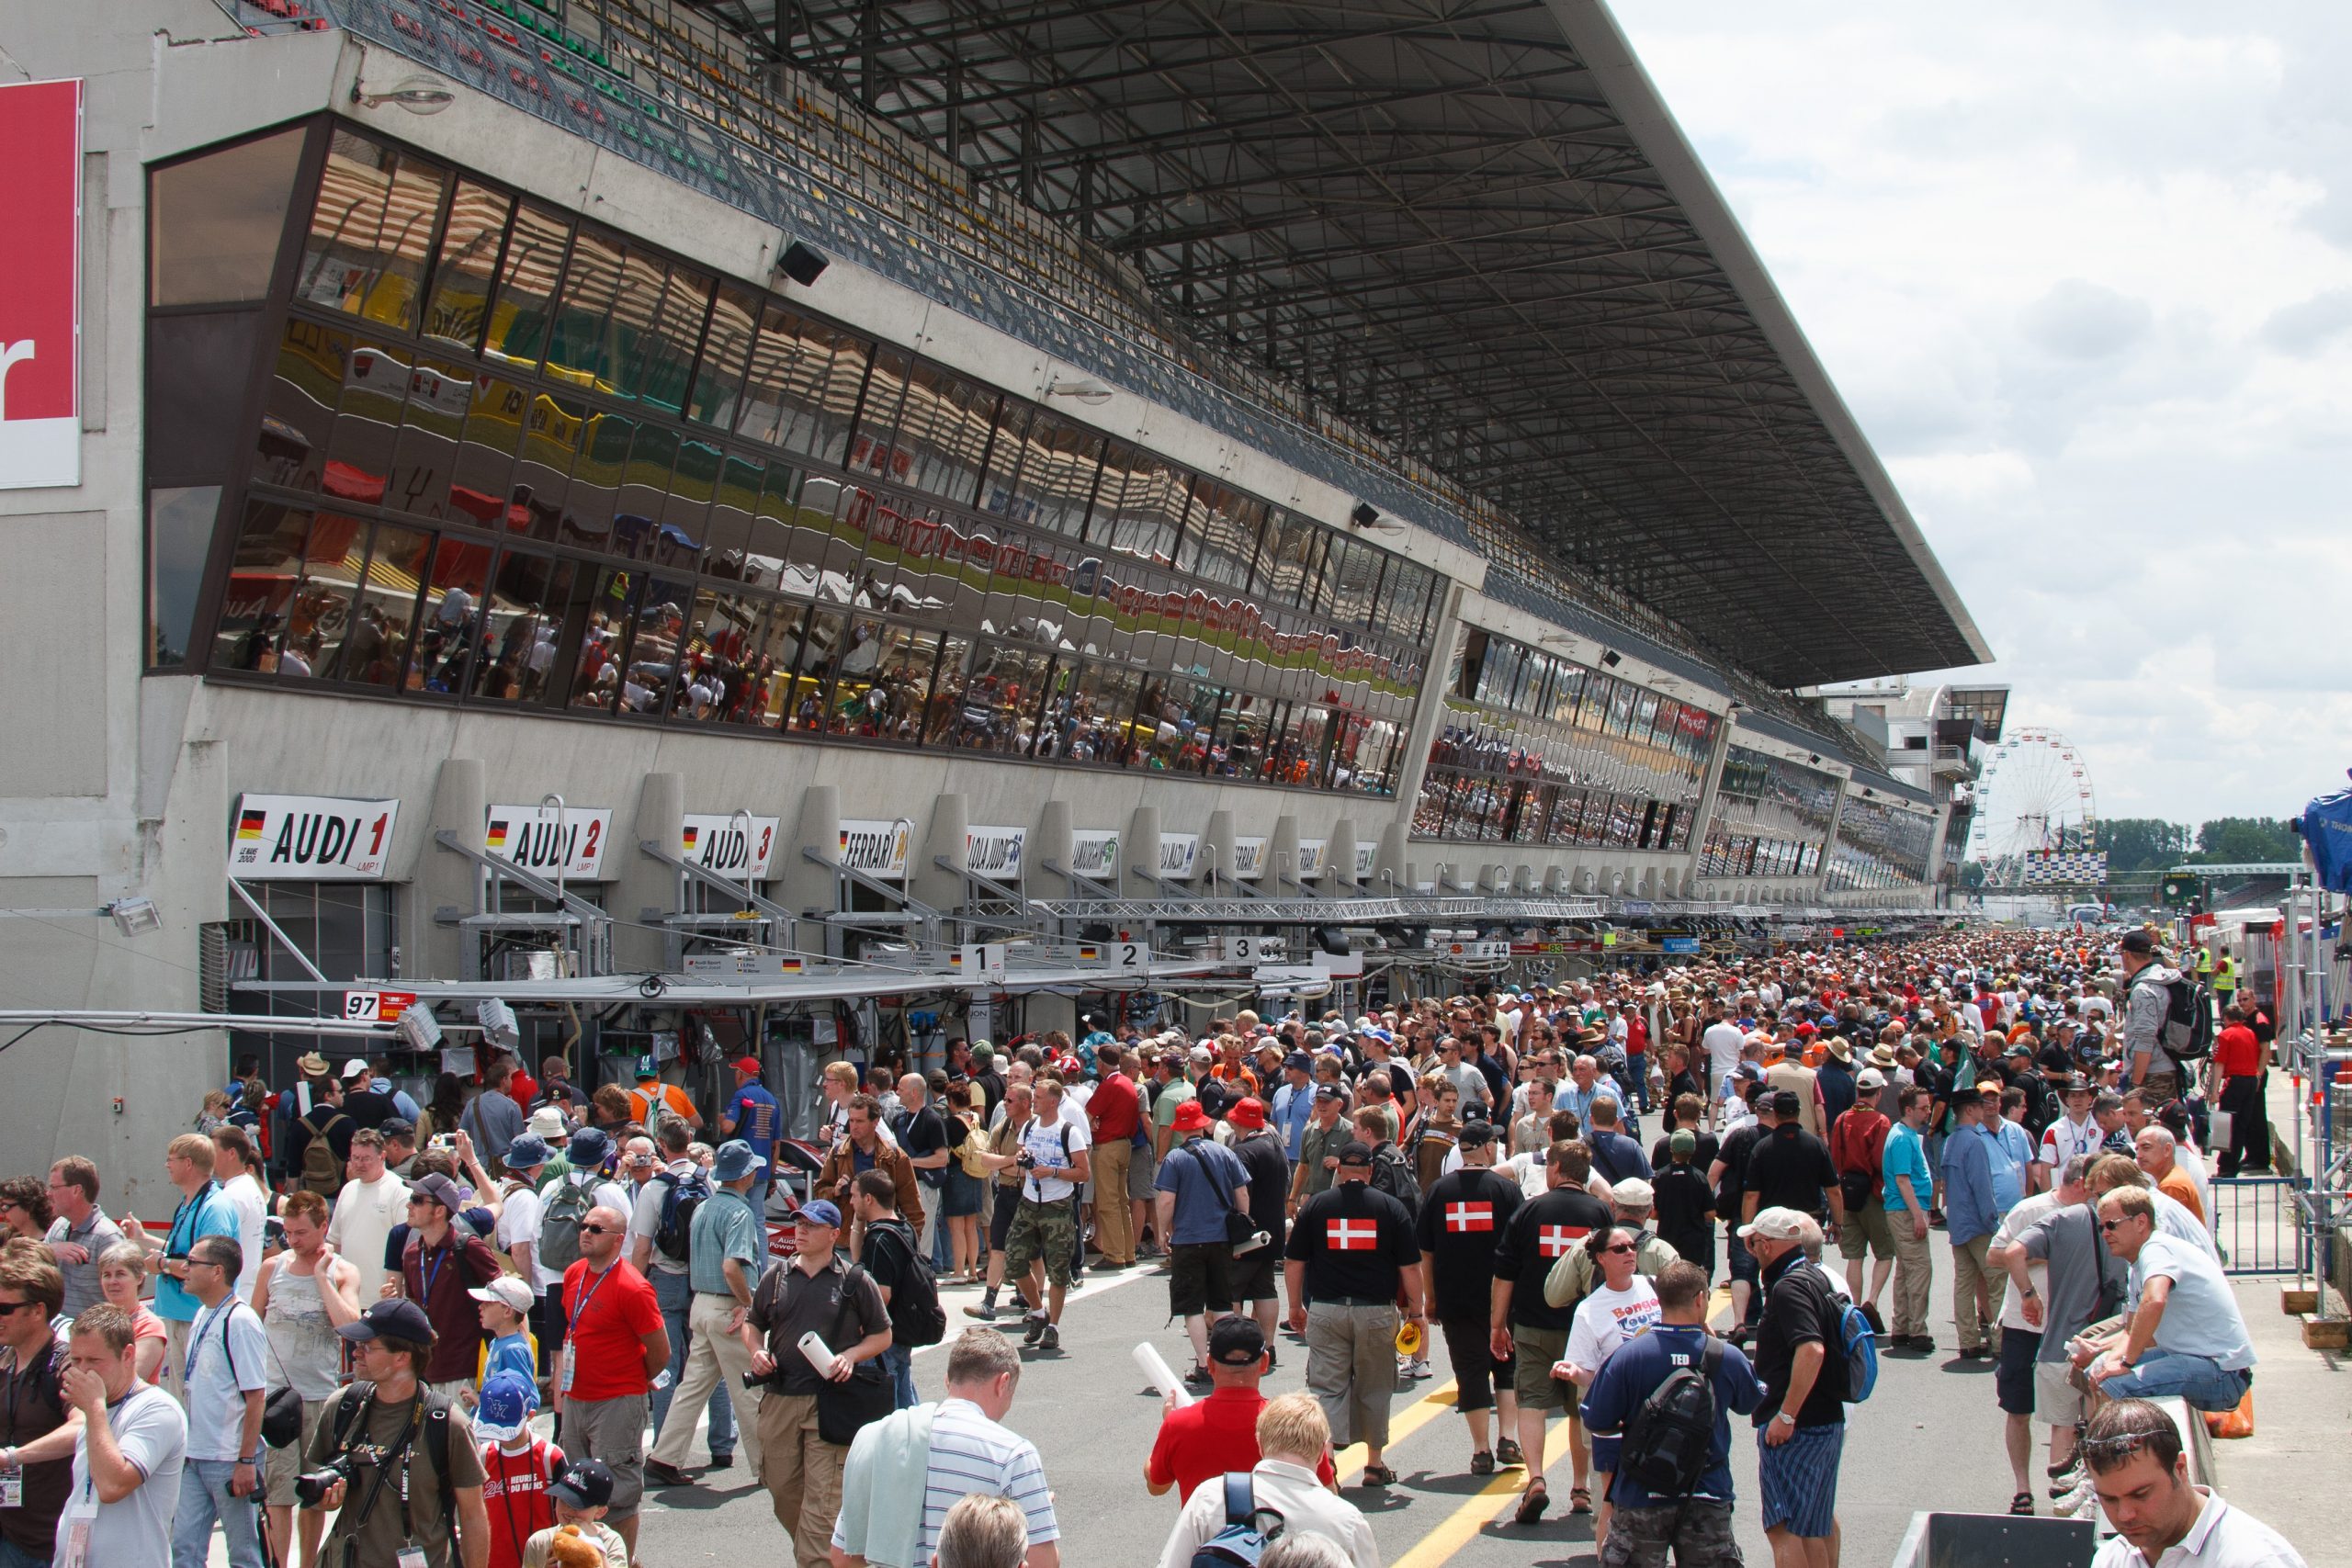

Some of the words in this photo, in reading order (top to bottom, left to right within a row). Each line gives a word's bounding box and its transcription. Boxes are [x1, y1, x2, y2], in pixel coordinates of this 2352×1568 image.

[270, 813, 361, 863] AUDI
[369, 813, 388, 855] 1
[513, 822, 578, 866] AUDI
[582, 819, 601, 857] 2
[758, 826, 772, 861] 3
[845, 833, 895, 870] FERRARI
[968, 836, 989, 870] LOLA
[1123, 945, 1136, 965] 2
[1236, 939, 1249, 957] 3
[1494, 943, 1508, 955] 44
[1549, 944, 1562, 953] 83
[976, 947, 986, 970] 1
[347, 997, 377, 1015] 97
[769, 1242, 794, 1250] Power
[1670, 1354, 1690, 1365] TED
[511, 1483, 521, 1493] DU
[522, 1481, 543, 1491] MANS
